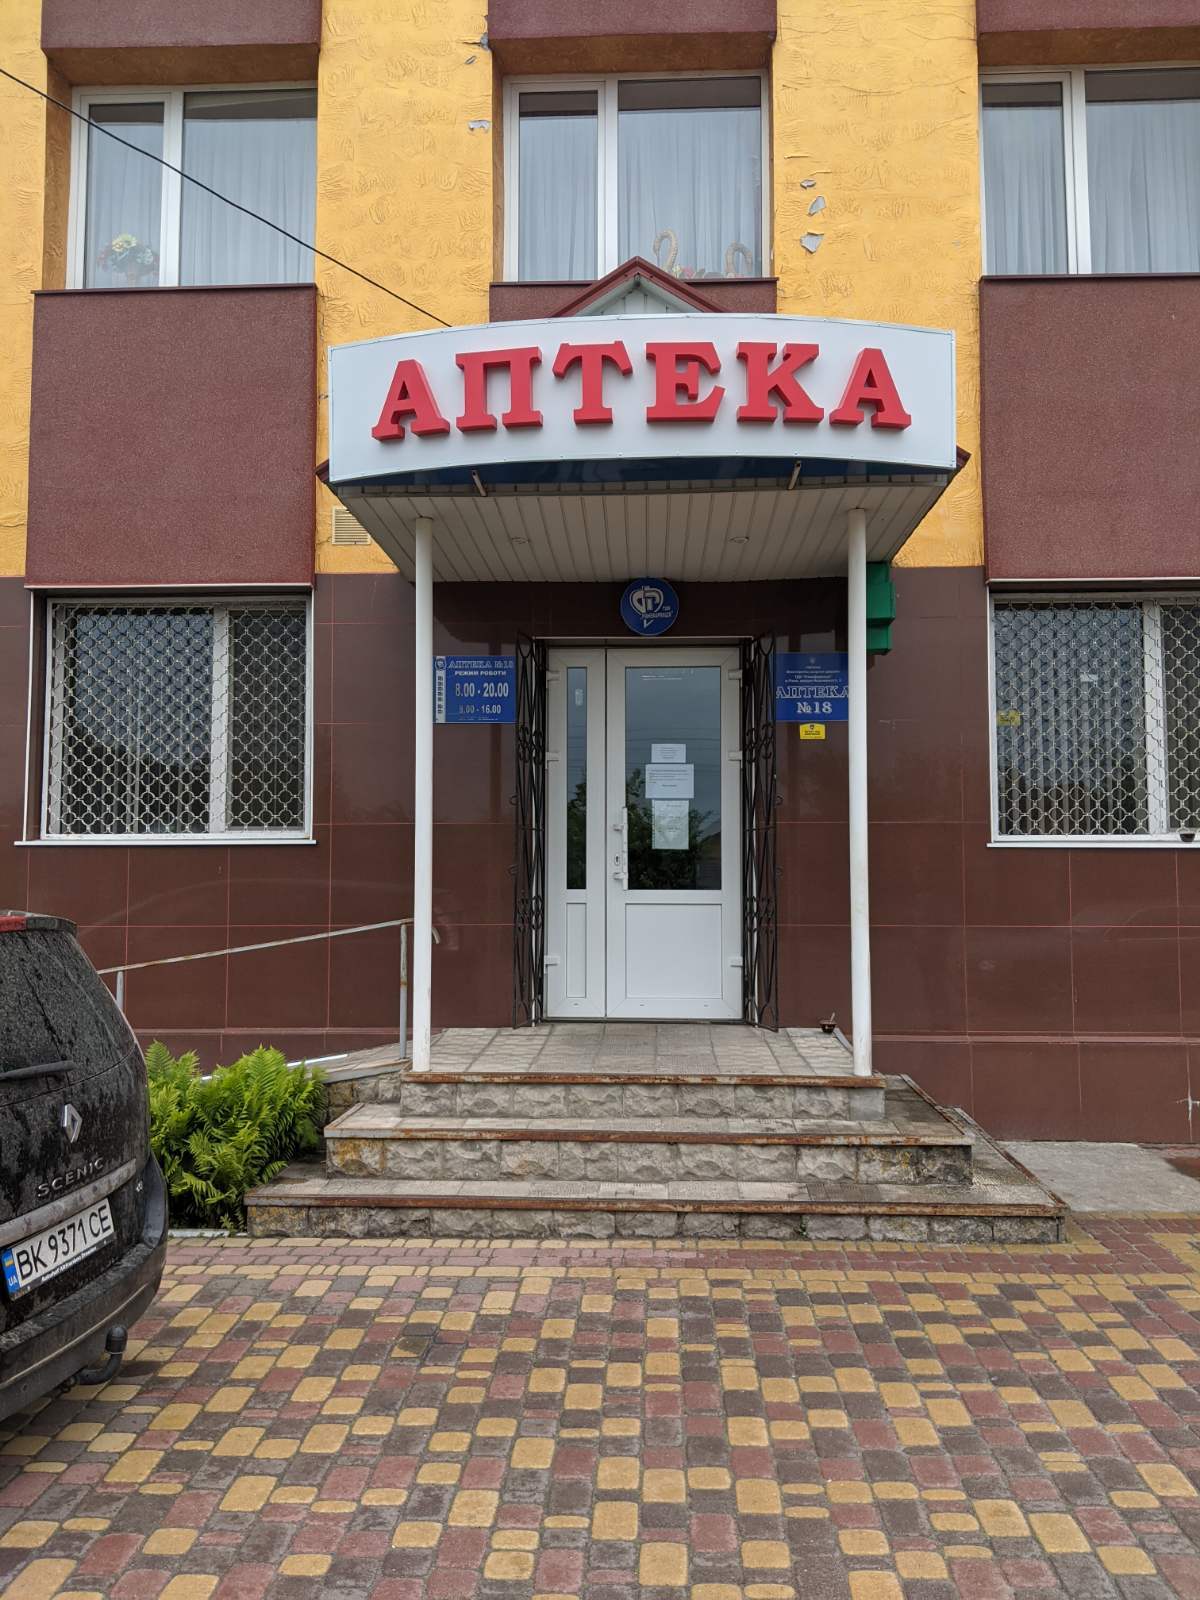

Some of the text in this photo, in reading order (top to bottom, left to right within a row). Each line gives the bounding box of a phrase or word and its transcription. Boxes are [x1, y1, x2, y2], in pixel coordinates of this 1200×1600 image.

[371, 340, 912, 442] АПТЕКА
[455, 682, 475, 697] 8.00
[483, 682, 509, 697] 20.00
[481, 704, 502, 714] 16.00
[38, 1157, 104, 1197] SCENIC
[16, 1240, 48, 1281] BK
[48, 1218, 87, 1264] 9371
[89, 1205, 111, 1238] CE
[8, 1275, 18, 1287] UA
